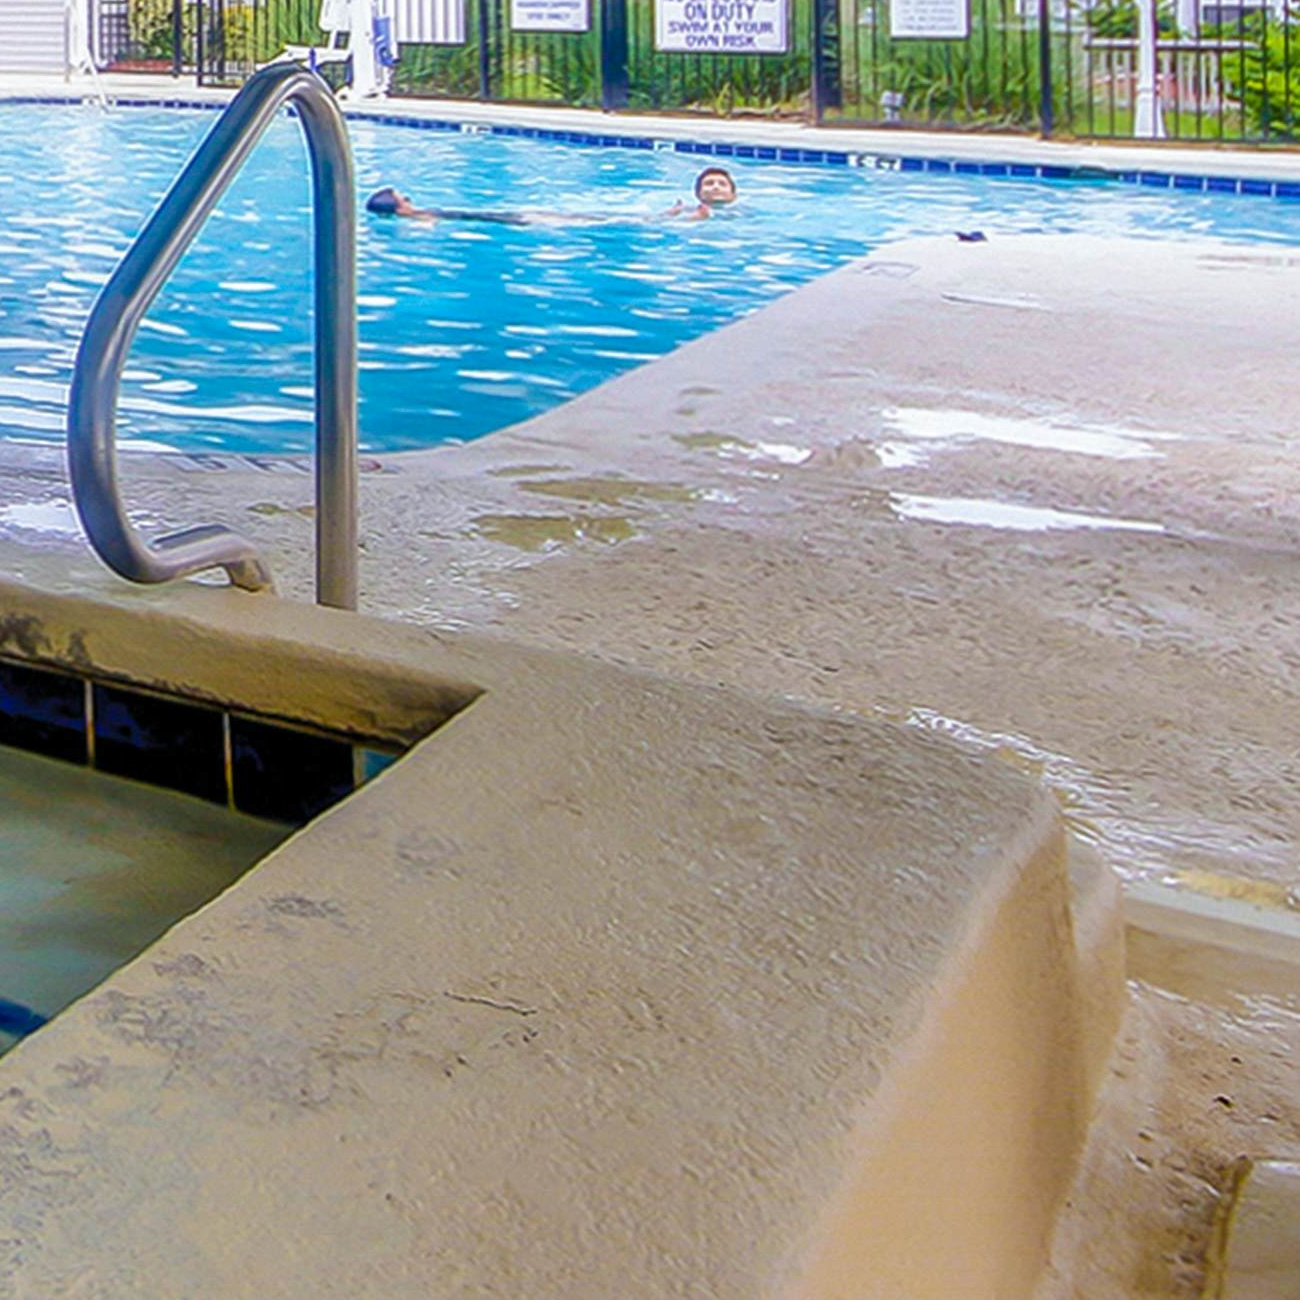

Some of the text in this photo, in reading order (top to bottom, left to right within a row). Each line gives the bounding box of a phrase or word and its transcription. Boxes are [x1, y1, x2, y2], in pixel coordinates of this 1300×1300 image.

[684, 2, 755, 20] ON DUTY
[668, 21, 774, 33] SWIM AT YOUR
[685, 35, 756, 47] OWN RISK
